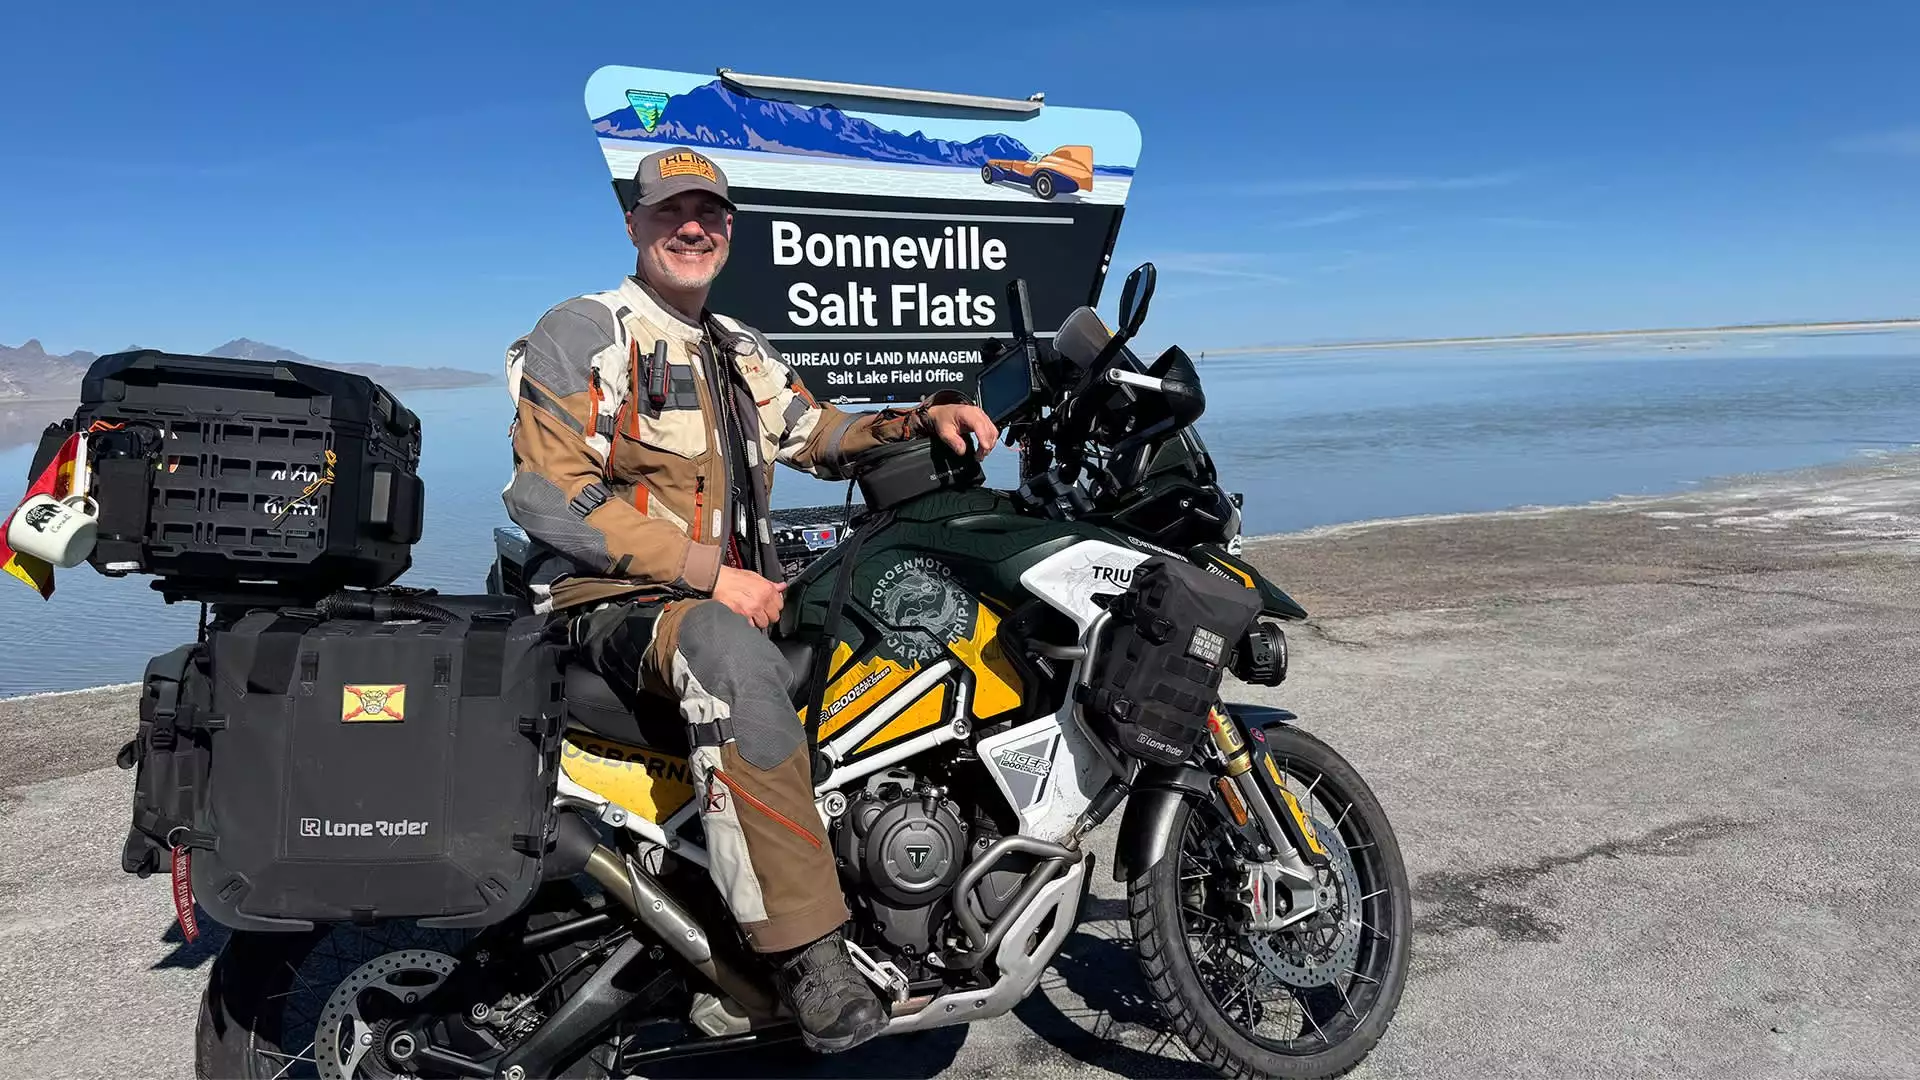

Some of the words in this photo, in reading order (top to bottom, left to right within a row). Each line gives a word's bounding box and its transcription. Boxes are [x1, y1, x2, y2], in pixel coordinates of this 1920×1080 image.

[771, 220, 1007, 271] Bonneville
[788, 281, 878, 327] Salt
[891, 282, 996, 327] Flats
[782, 352, 839, 366] BUREAU
[843, 352, 863, 366] OF
[866, 351, 903, 365] LAND
[907, 350, 983, 365] MANAGEM
[827, 370, 854, 385] Salt
[857, 370, 888, 384] Lake
[891, 369, 922, 384] Field
[925, 368, 964, 383] Office
[871, 557, 951, 608] TOROENMOTO
[1092, 565, 1132, 584] TRIU
[829, 690, 856, 716] 1200
[1000, 760, 1021, 770] 1200
[1002, 749, 1051, 771] TIGER
[325, 820, 374, 837] Lone
[375, 819, 429, 837] Rider
